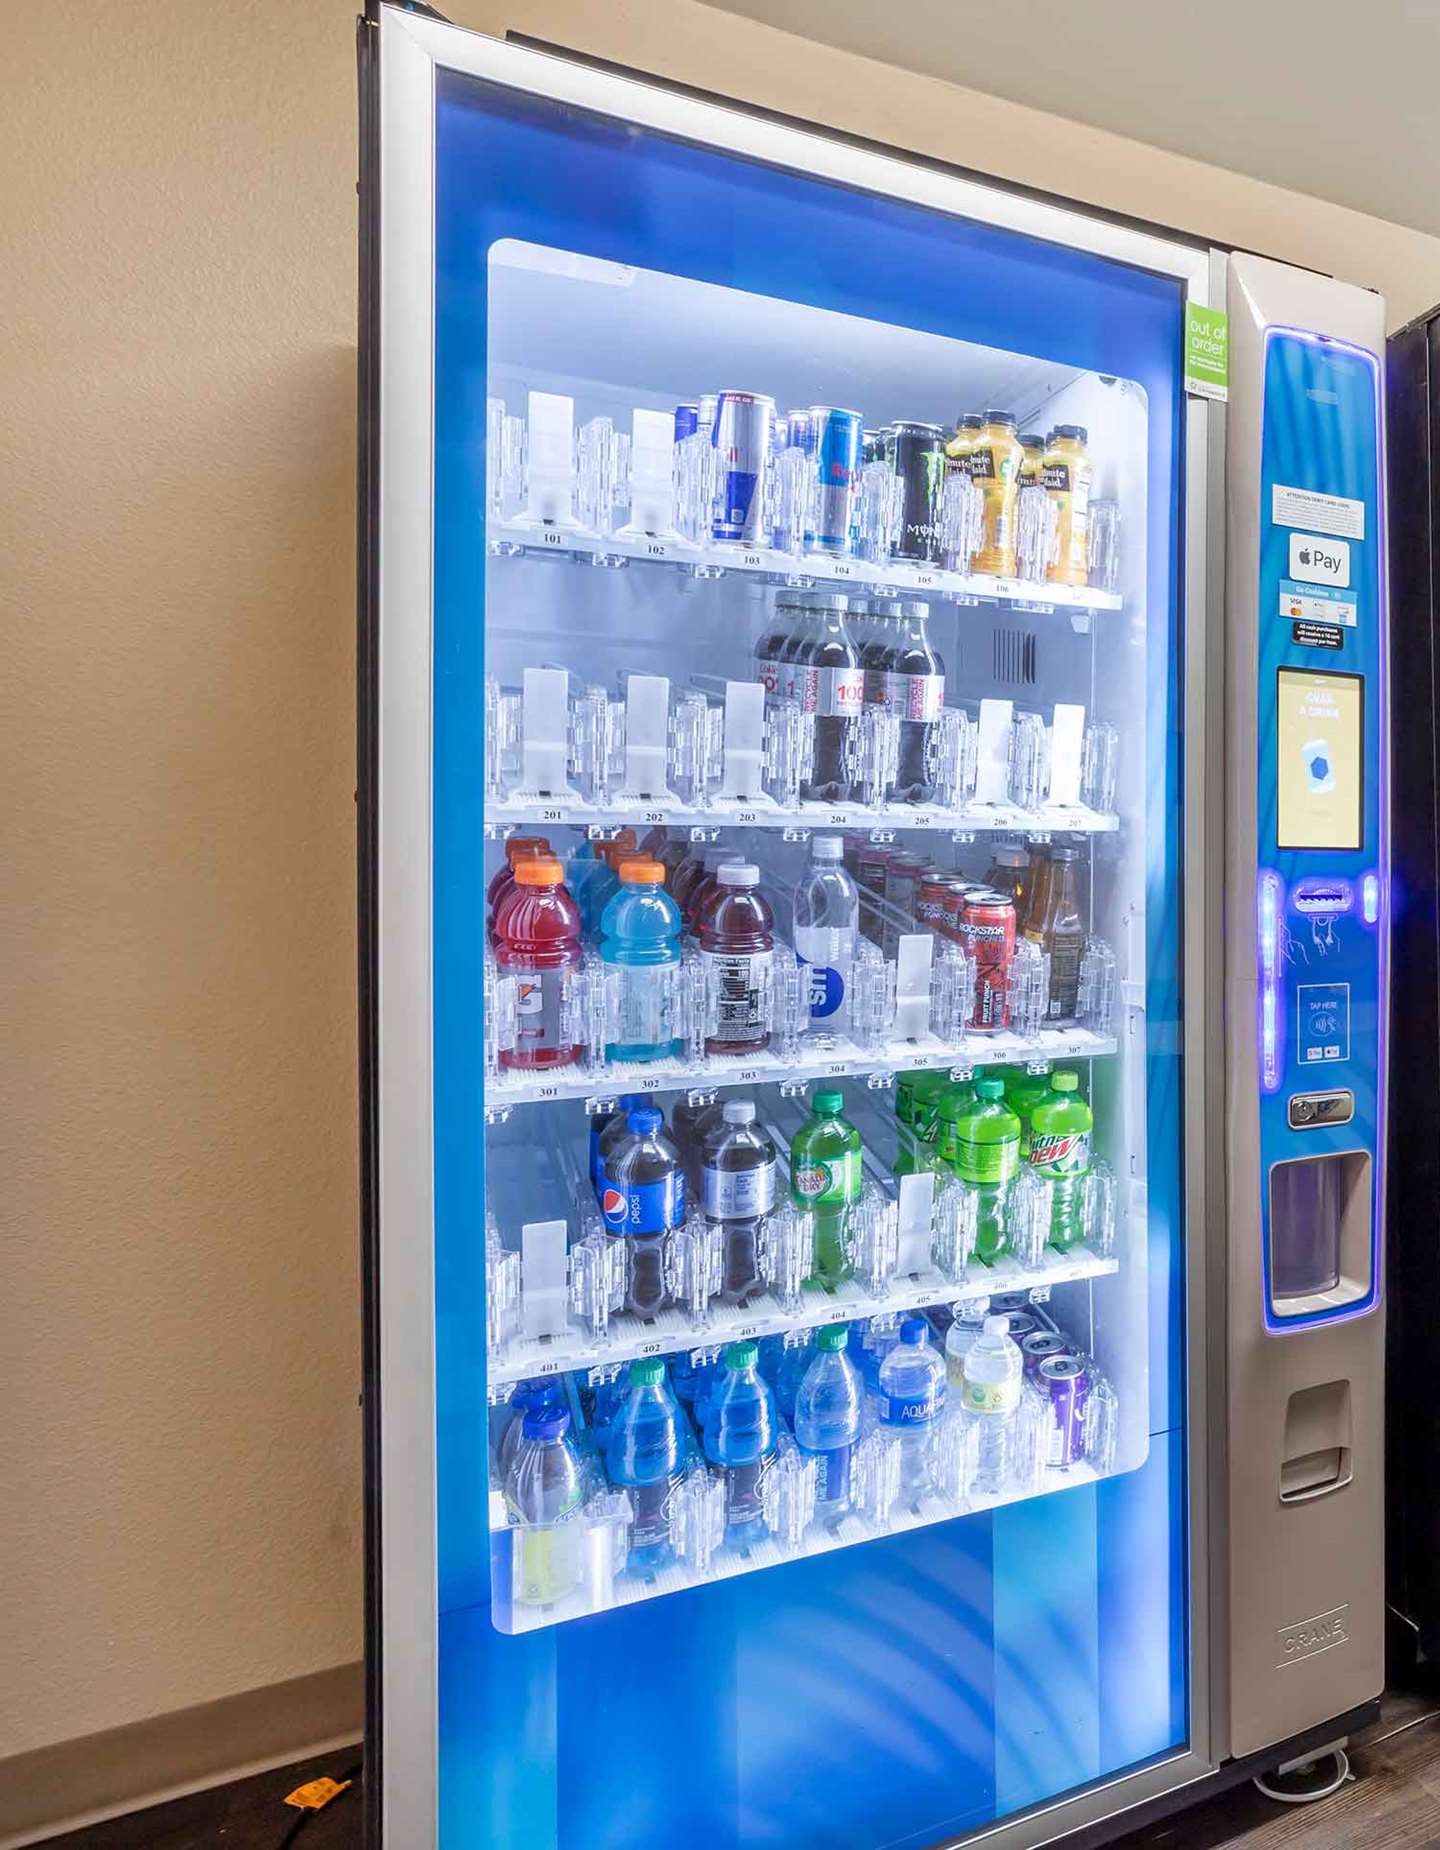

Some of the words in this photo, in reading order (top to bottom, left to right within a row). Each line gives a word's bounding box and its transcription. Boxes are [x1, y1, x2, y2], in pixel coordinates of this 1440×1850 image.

[545, 534, 561, 545] 101
[648, 544, 665, 555] 102
[745, 555, 760, 566] 103
[1313, 550, 1341, 574] Pay
[544, 811, 561, 820] 201
[645, 813, 663, 822] 202
[739, 812, 756, 822] 203
[830, 815, 846, 824] 204
[915, 816, 930, 825] 205
[829, 1064, 845, 1074] 304
[739, 1071, 757, 1081] 303
[641, 1079, 660, 1089] 302
[539, 1088, 558, 1097] 301
[631, 1194, 641, 1224] pepsi
[740, 1327, 757, 1336] 403
[642, 1343, 661, 1353] 402
[1283, 1617, 1345, 1654] CRANE
